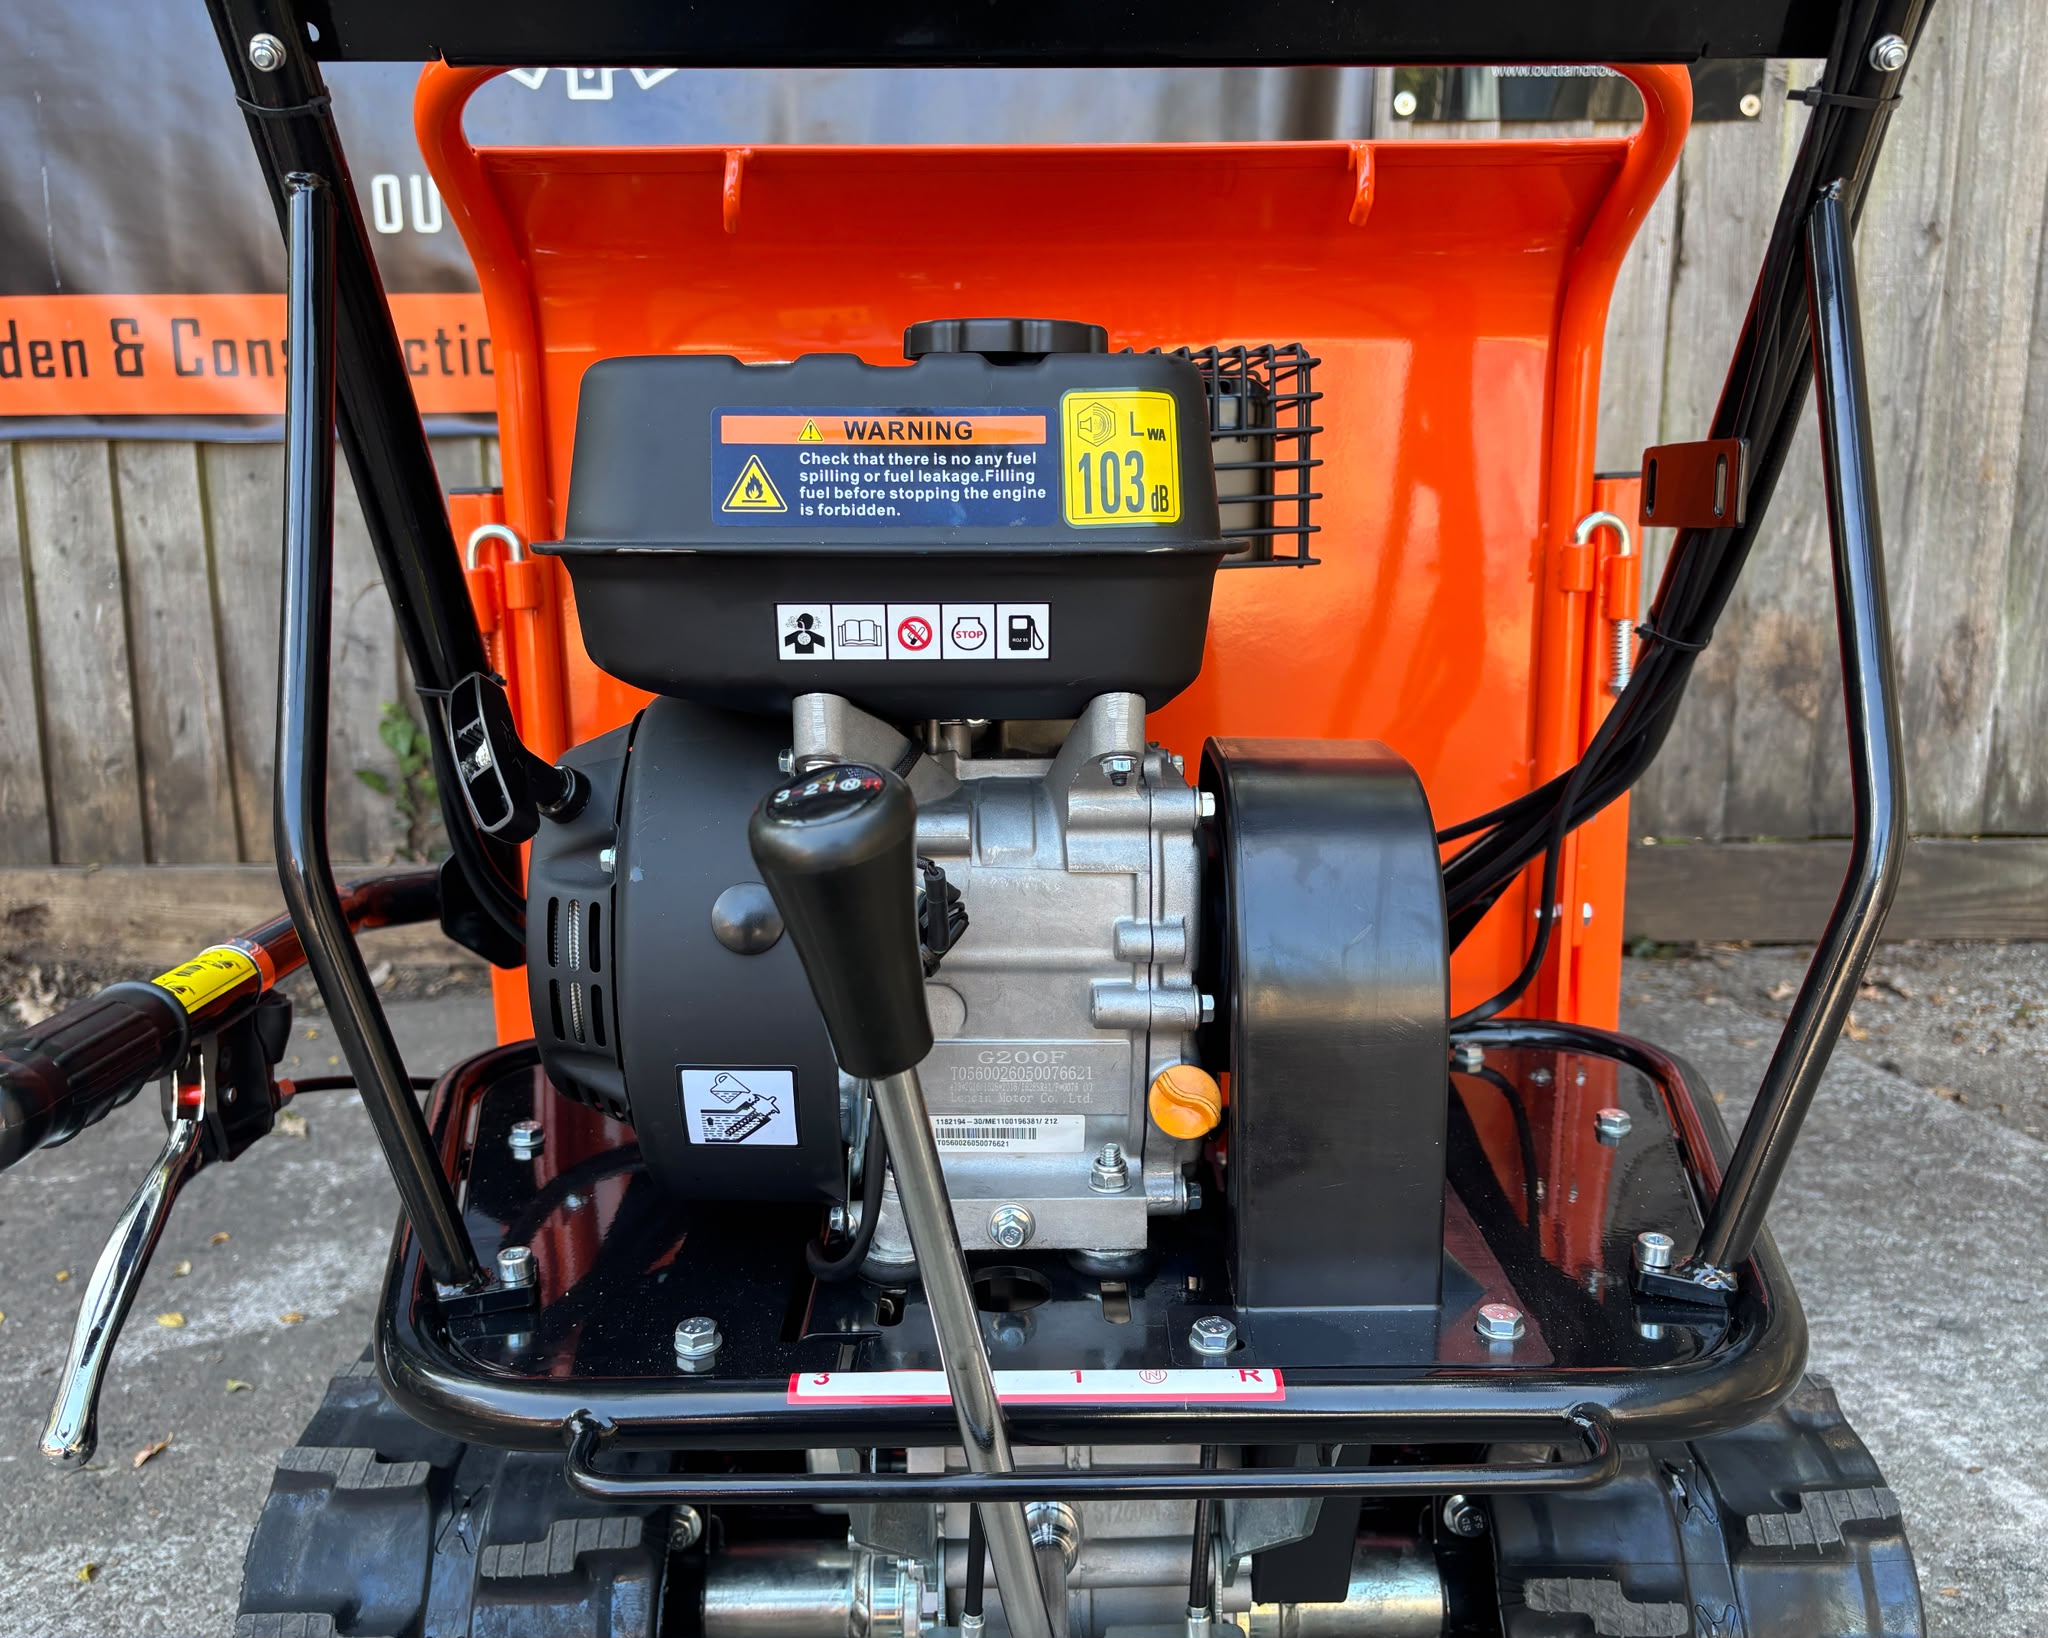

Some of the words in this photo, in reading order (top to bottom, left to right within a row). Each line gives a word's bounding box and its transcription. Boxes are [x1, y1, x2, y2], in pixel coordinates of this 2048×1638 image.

[110, 318, 144, 377] &
[844, 420, 973, 441] WARNING
[800, 452, 850, 465] Check
[853, 452, 885, 465] that
[888, 452, 929, 465] there
[933, 452, 947, 465] is
[951, 455, 971, 465] no
[974, 455, 1003, 467] any
[1006, 452, 1037, 465] fuel
[800, 470, 860, 485] spilling
[864, 471, 880, 482] or
[884, 470, 914, 482] fuel
[1078, 450, 1145, 514] 103
[1151, 485, 1169, 513] dB
[800, 487, 830, 499] fuel
[834, 487, 886, 499] before
[889, 487, 960, 502] stopping
[964, 487, 989, 499] the
[992, 487, 1047, 501] engine
[800, 503, 814, 516] is
[818, 503, 901, 516] forbidden.
[955, 630, 983, 639] STOP
[978, 1051, 1067, 1064] G200F
[813, 1372, 830, 1386] 3
[1070, 1369, 1082, 1383] 1
[1239, 1368, 1263, 1382] R
